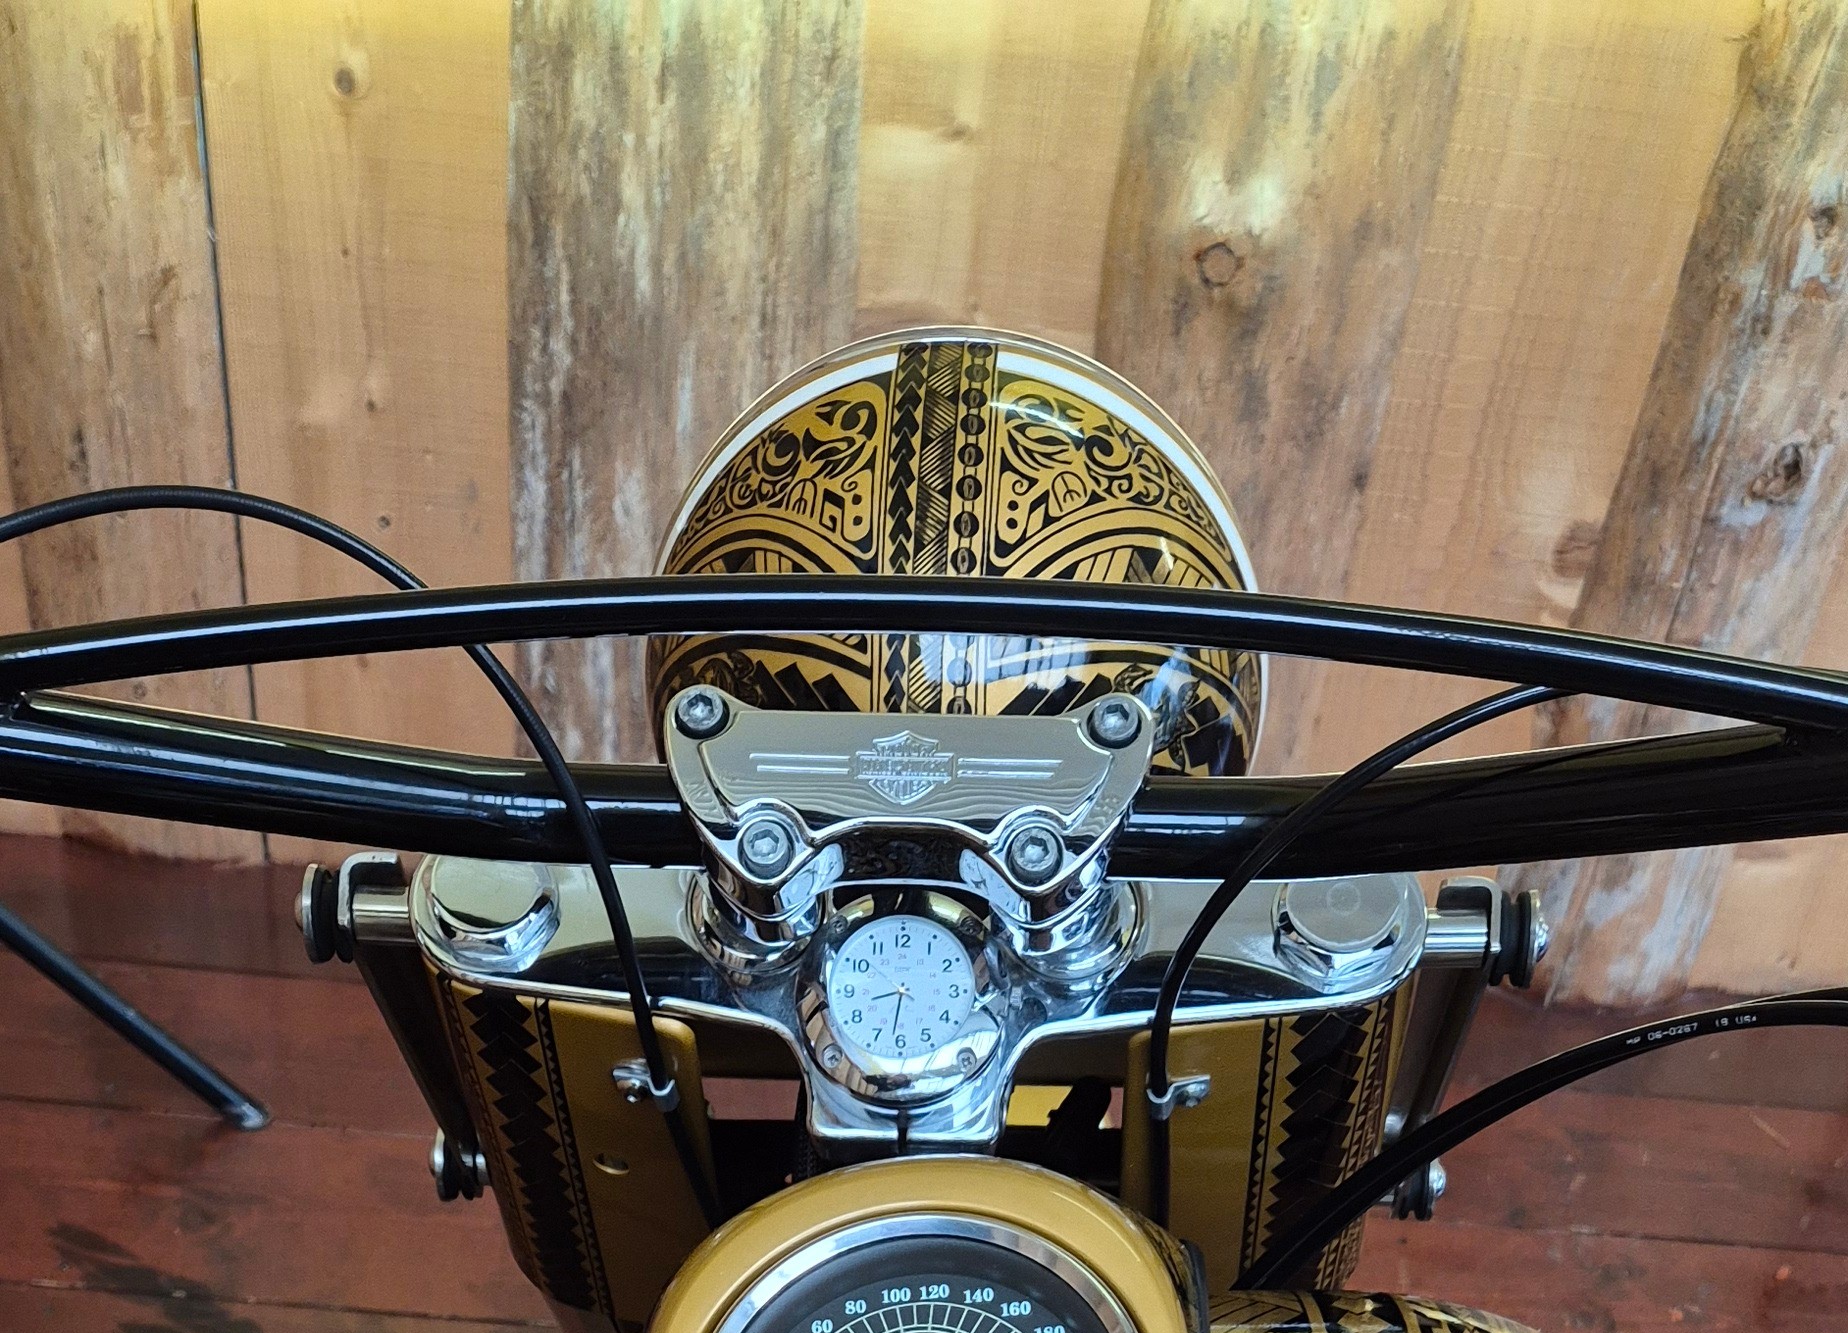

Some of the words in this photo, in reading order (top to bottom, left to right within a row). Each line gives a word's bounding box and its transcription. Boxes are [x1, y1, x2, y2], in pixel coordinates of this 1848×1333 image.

[872, 942, 884, 955] 11
[895, 934, 911, 948] 12
[927, 942, 932, 955] 1
[852, 958, 870, 973] 10
[941, 958, 953, 973] 2
[843, 984, 855, 998] 9
[949, 984, 960, 998] 3
[851, 1009, 862, 1024] 8
[939, 1009, 951, 1024] 4
[872, 1028, 883, 1042] 7
[895, 1034, 906, 1049] 6
[920, 1028, 931, 1042] 5
[881, 1287, 911, 1303] 100
[919, 1284, 950, 1300] 120
[963, 1287, 994, 1303] 140
[845, 1299, 867, 1315] 80
[1000, 1301, 1032, 1317] 160
